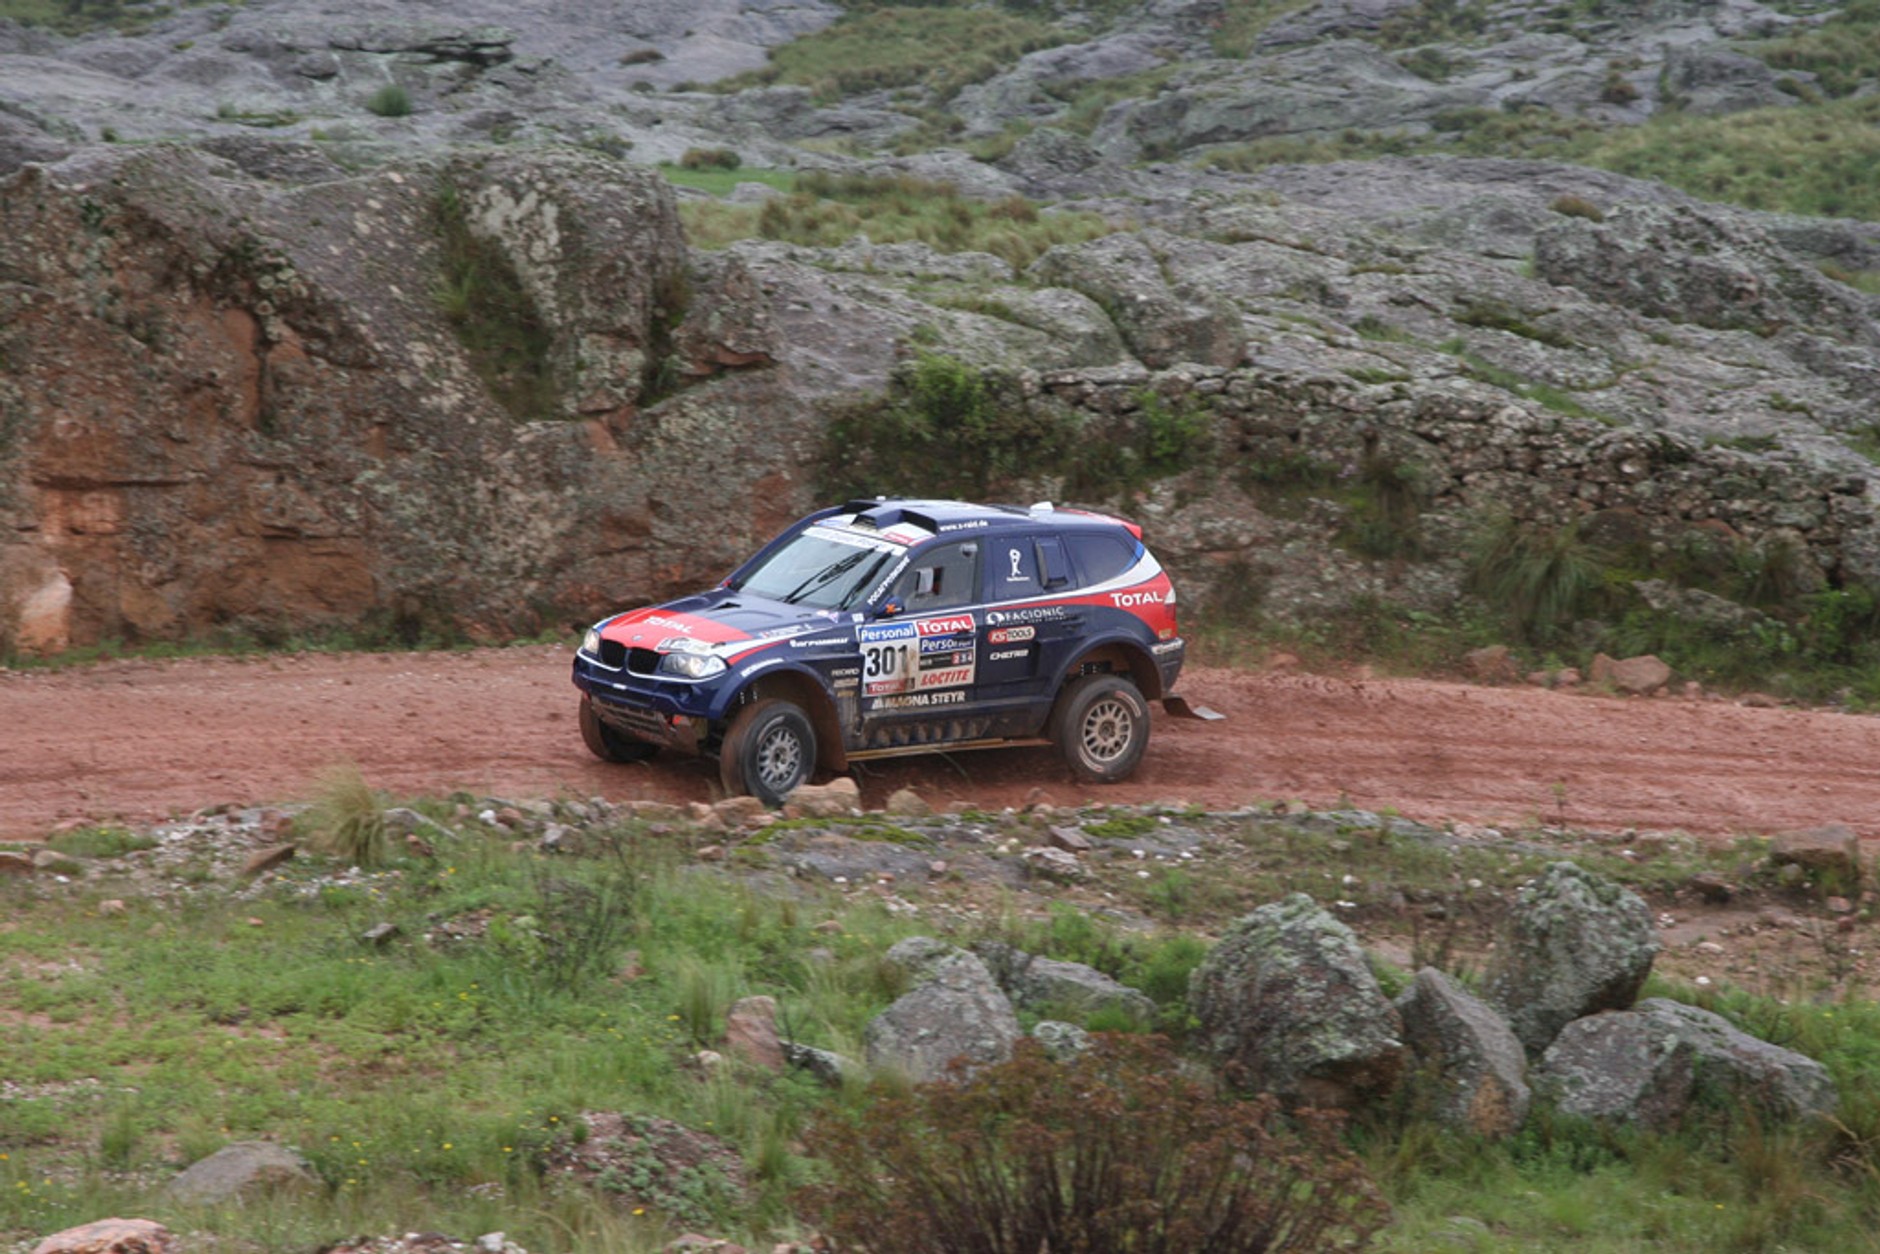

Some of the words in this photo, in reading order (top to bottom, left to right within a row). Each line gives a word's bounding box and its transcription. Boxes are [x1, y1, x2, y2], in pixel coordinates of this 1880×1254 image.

[1110, 592, 1163, 607] TOTAL
[1004, 607, 1064, 620] FACIONIC
[643, 616, 690, 632] TOTAL
[918, 620, 970, 633] TOTAL
[861, 626, 913, 640] Personal
[1007, 628, 1032, 641] TOOLS
[866, 645, 908, 676] 301
[921, 669, 969, 686] LOCTITE
[885, 694, 930, 708] MAGNA
[931, 691, 965, 704] STEYR
